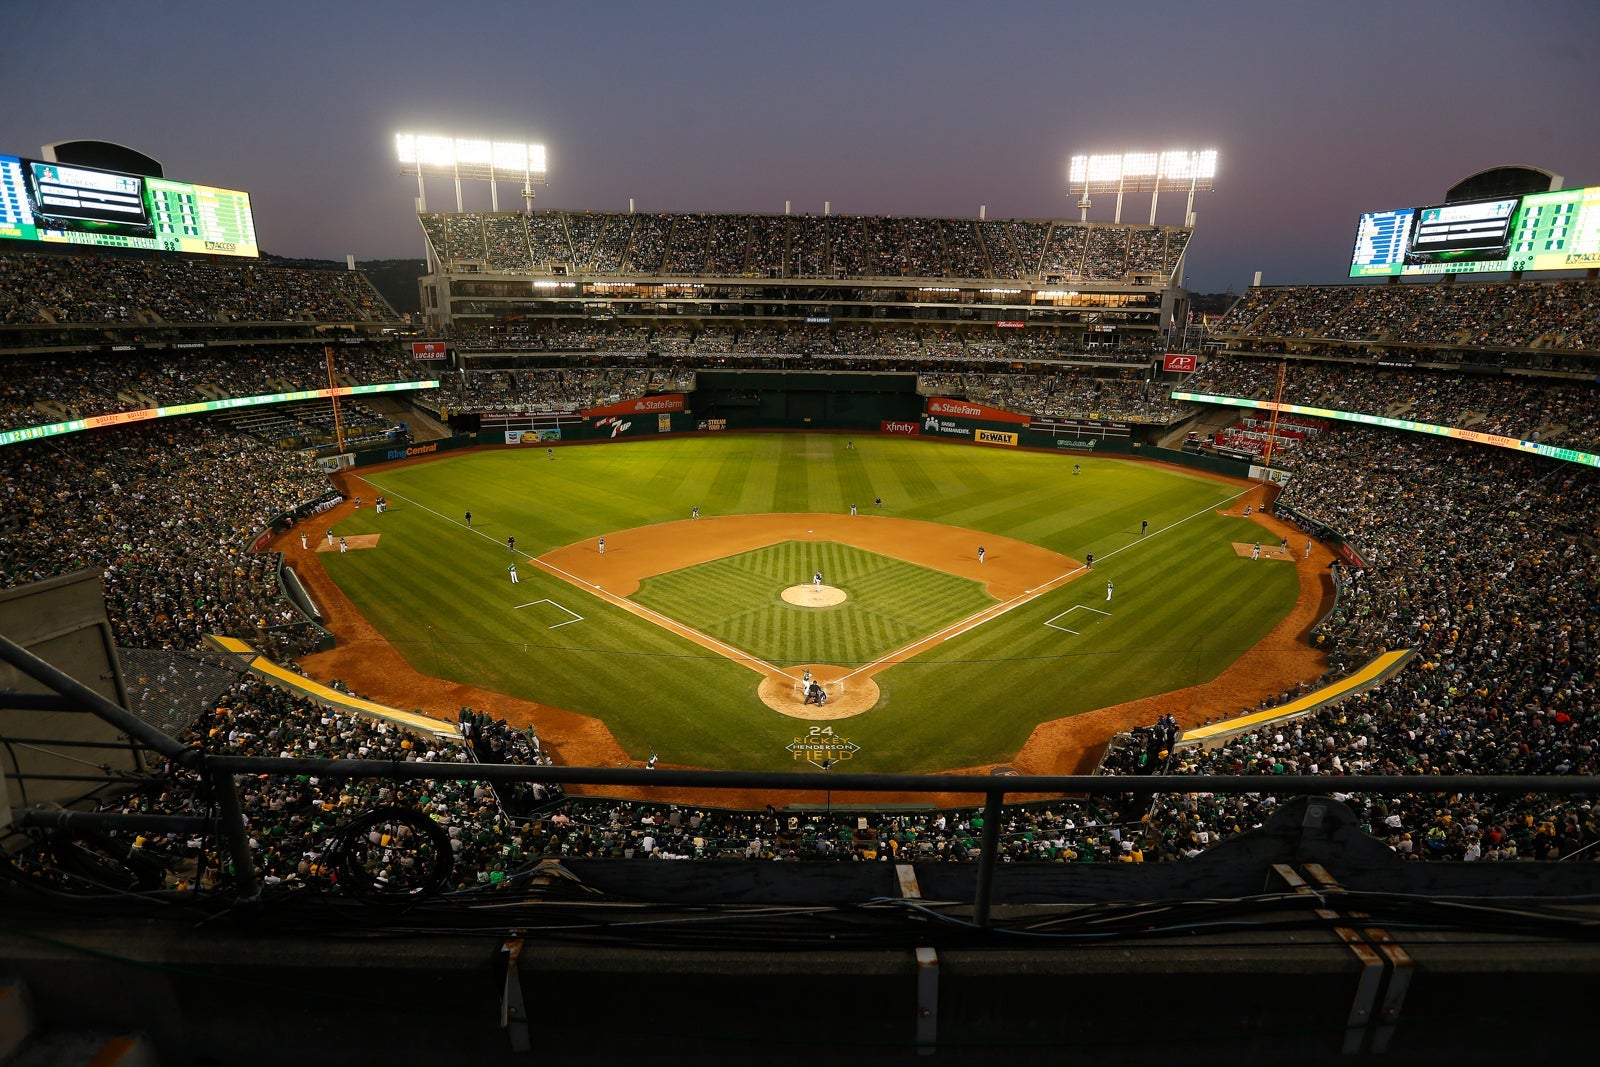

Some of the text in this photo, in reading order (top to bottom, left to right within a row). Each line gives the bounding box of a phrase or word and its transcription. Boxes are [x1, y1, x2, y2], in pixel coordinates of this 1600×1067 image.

[886, 422, 914, 433] xfinity
[809, 726, 834, 736] 24
[793, 750, 853, 760] FIELD
